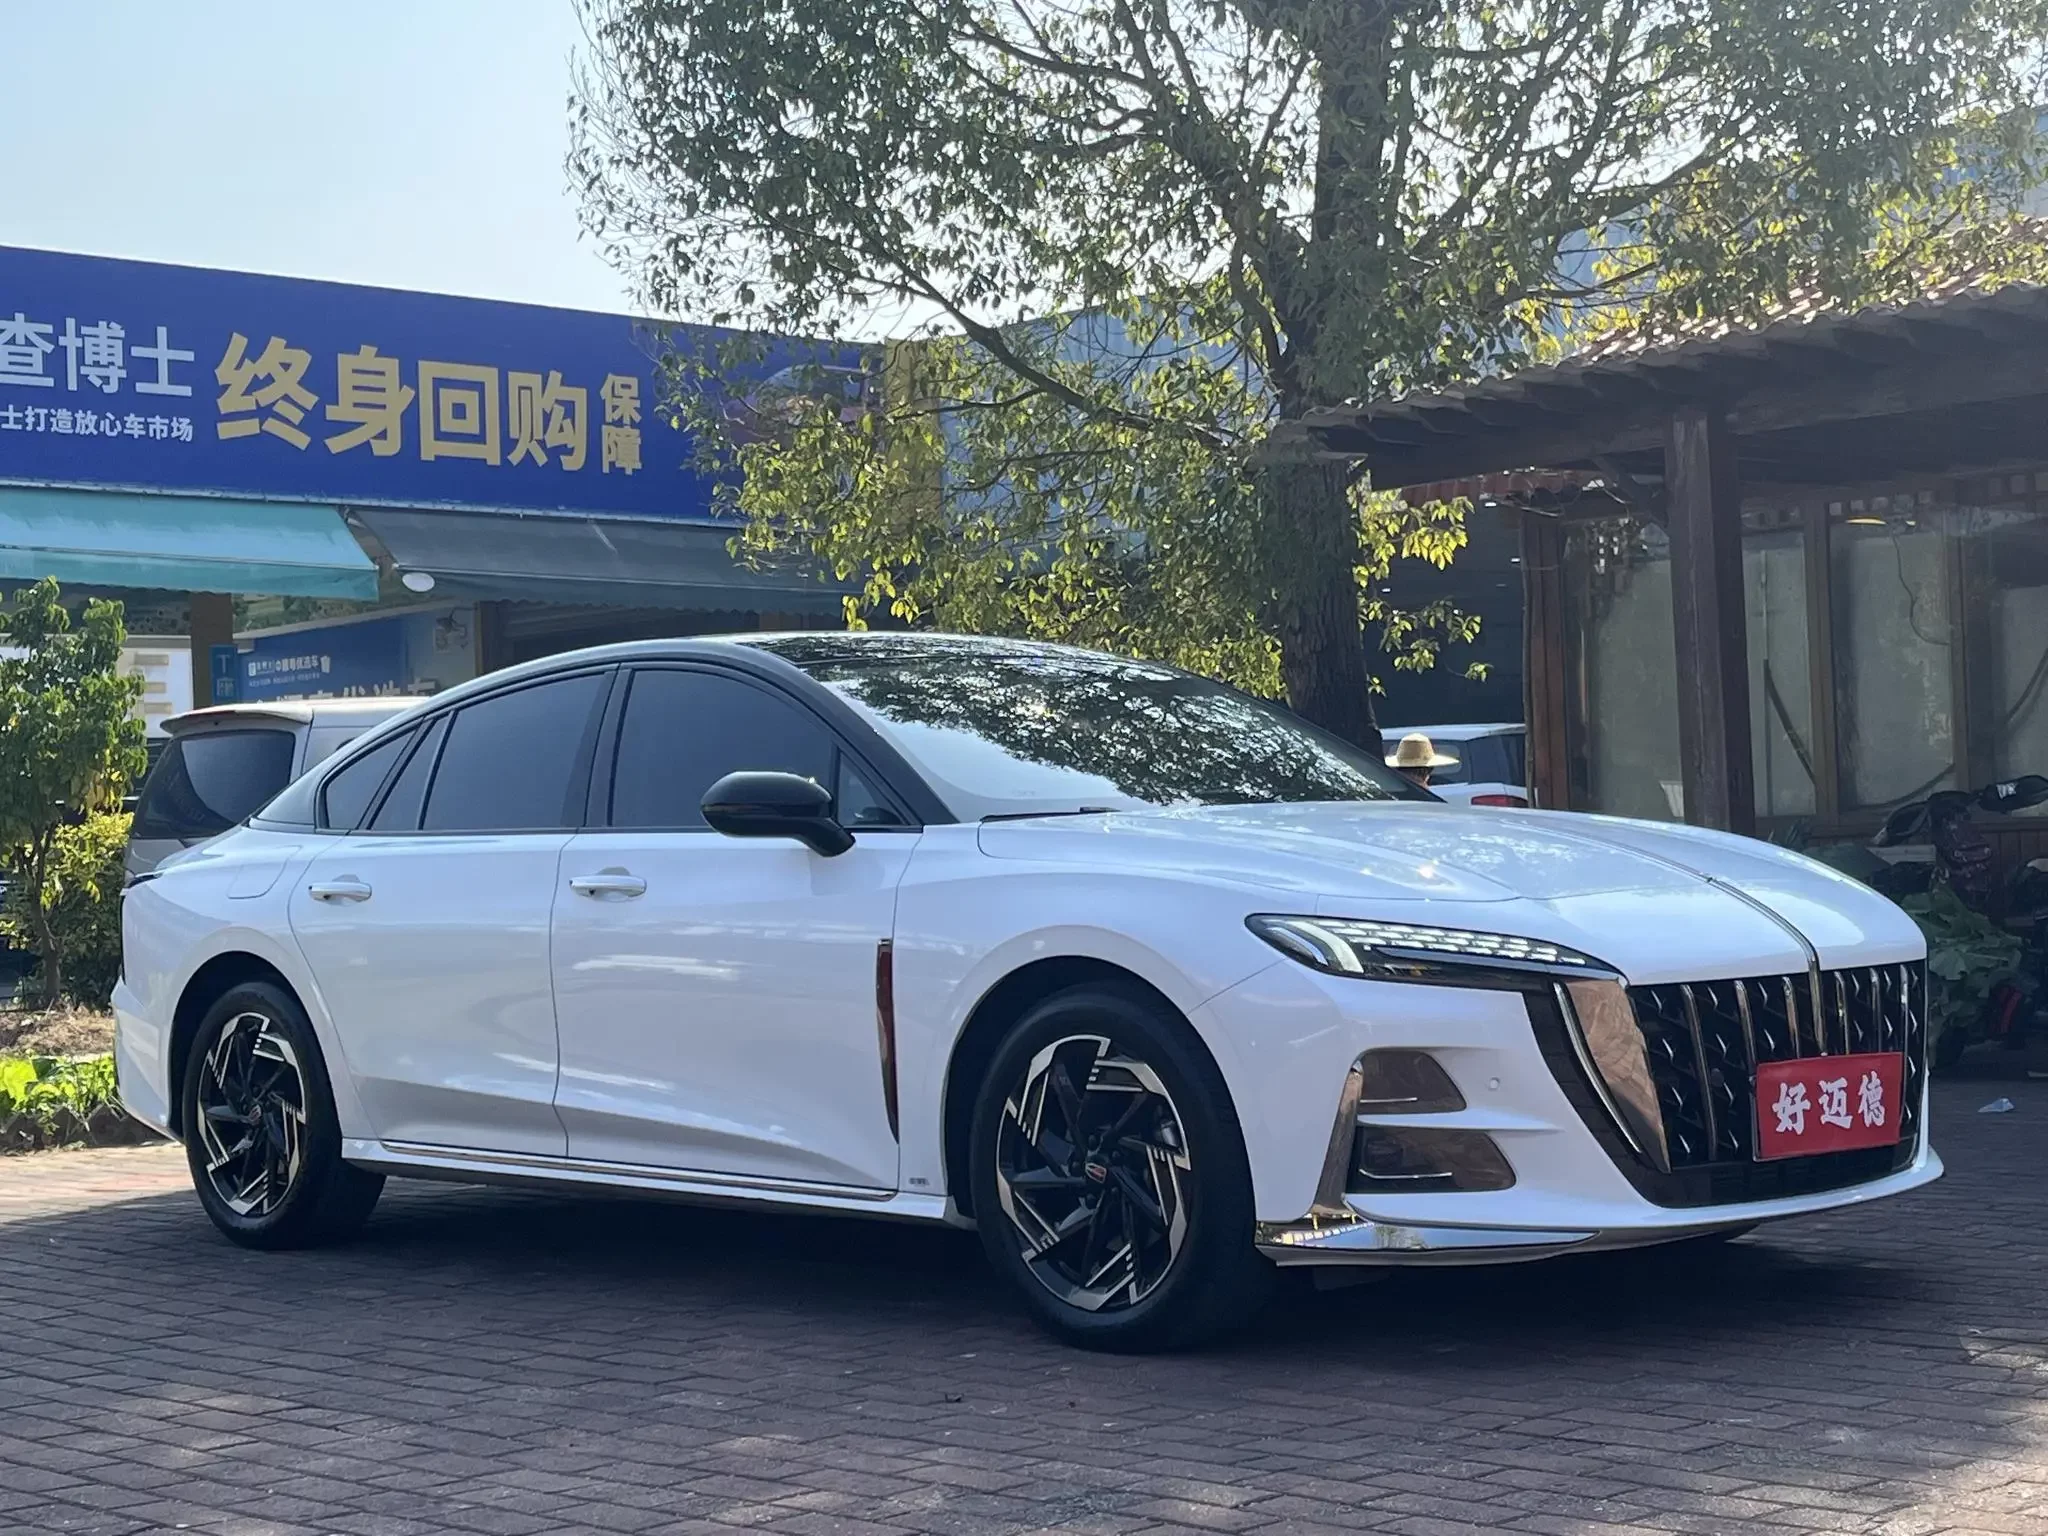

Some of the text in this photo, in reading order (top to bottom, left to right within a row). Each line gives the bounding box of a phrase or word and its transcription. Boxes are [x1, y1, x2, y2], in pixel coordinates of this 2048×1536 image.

[0, 312, 195, 397] 查博士
[0, 404, 194, 442] 士打造放心车市场
[214, 332, 588, 471] 终身回购
[600, 373, 642, 475] 保障
[1772, 1070, 1886, 1135] 好迈德
